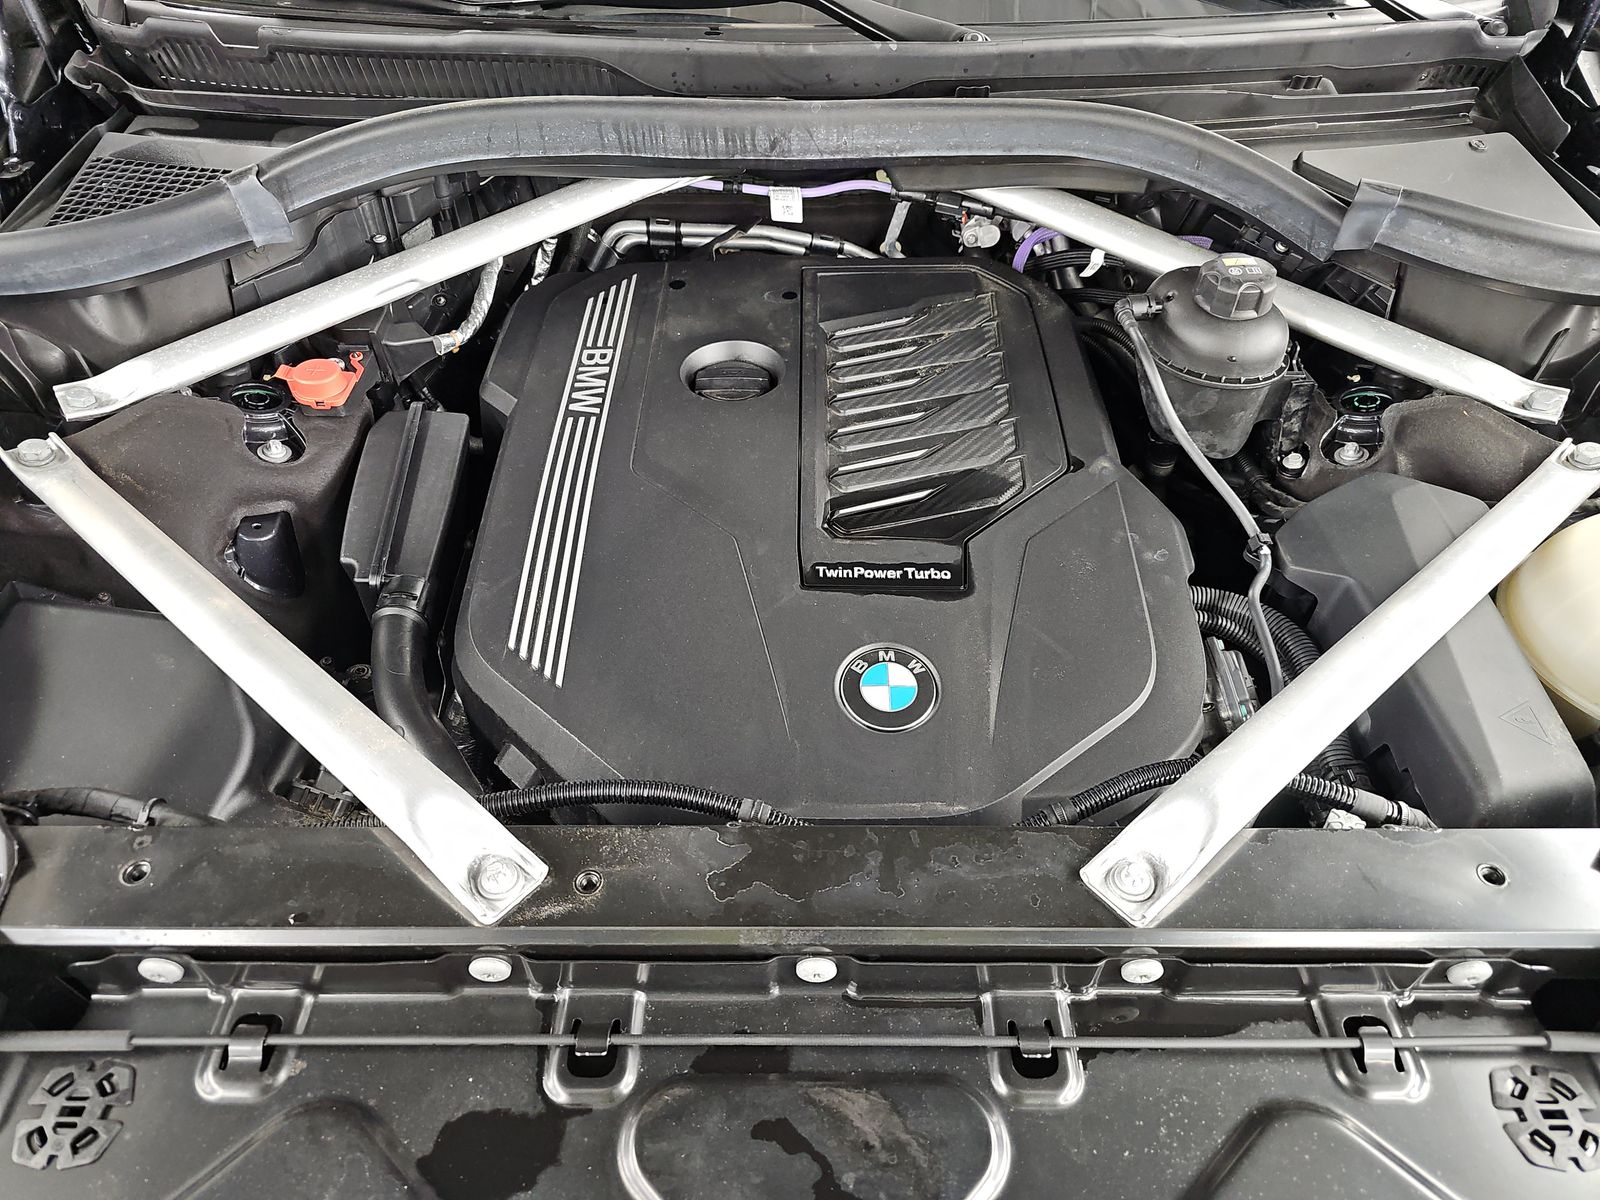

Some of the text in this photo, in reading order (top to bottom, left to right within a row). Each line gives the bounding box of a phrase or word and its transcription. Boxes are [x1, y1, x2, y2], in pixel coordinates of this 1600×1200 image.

[568, 348, 614, 414] BMW
[903, 567, 951, 580] Turbo
[850, 650, 926, 675] BMW
